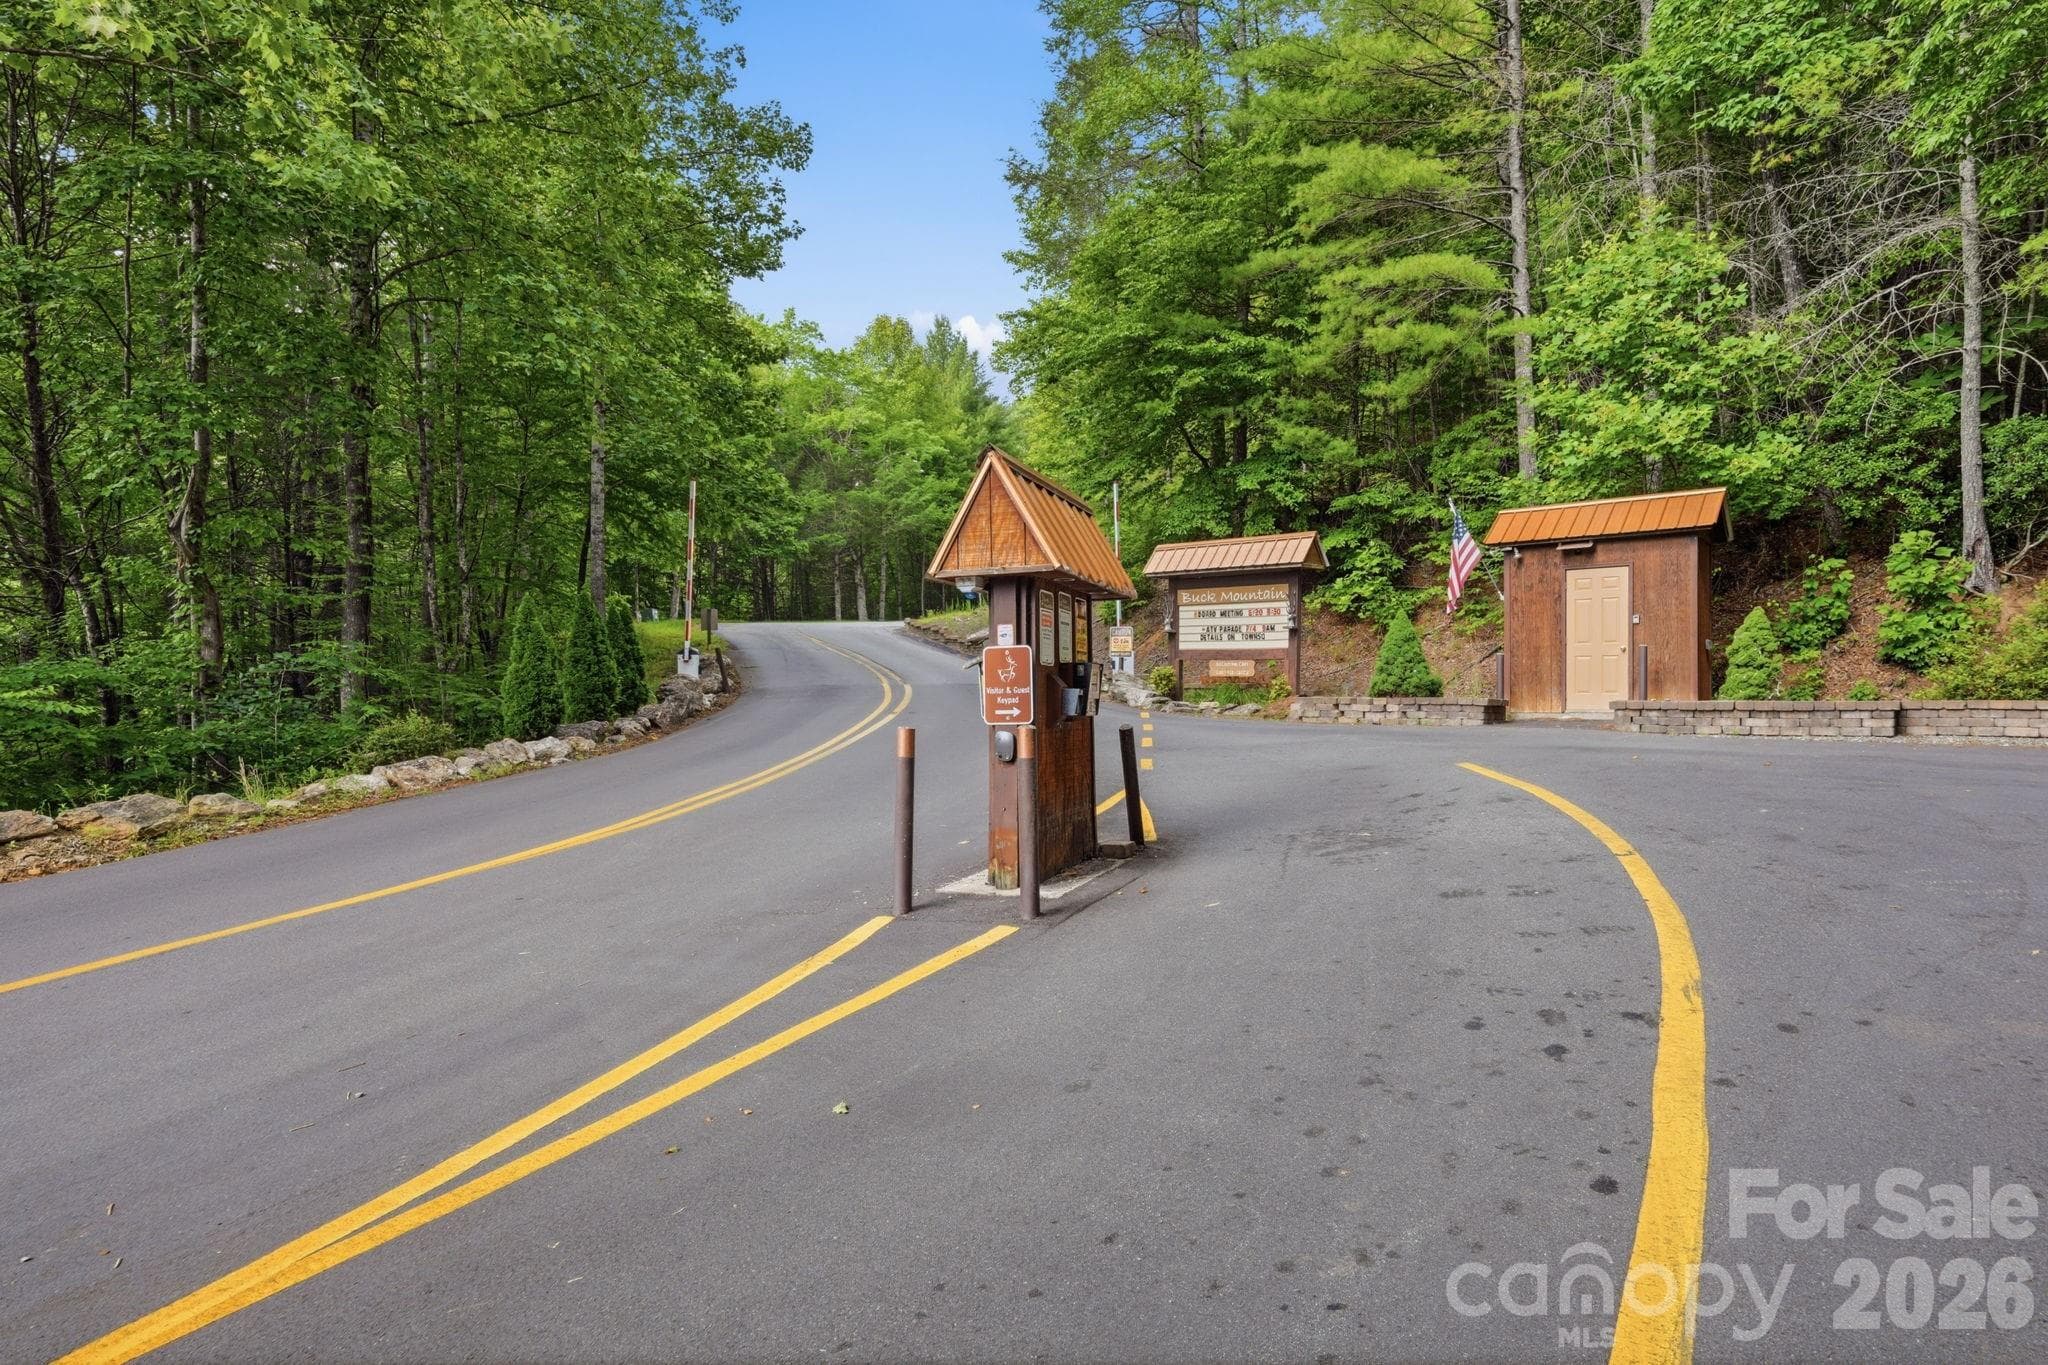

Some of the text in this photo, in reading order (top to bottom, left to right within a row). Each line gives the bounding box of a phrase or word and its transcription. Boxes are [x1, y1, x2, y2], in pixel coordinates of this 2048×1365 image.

[1181, 587, 1287, 603] Buck Mountain
[1220, 608, 1244, 617] MEETING
[1219, 625, 1242, 633] PARADE
[1200, 633, 1223, 641] DETAILS
[1227, 633, 1235, 641] ON
[986, 686, 1030, 695] Visitor & Guest
[997, 696, 1020, 705] Keypad
